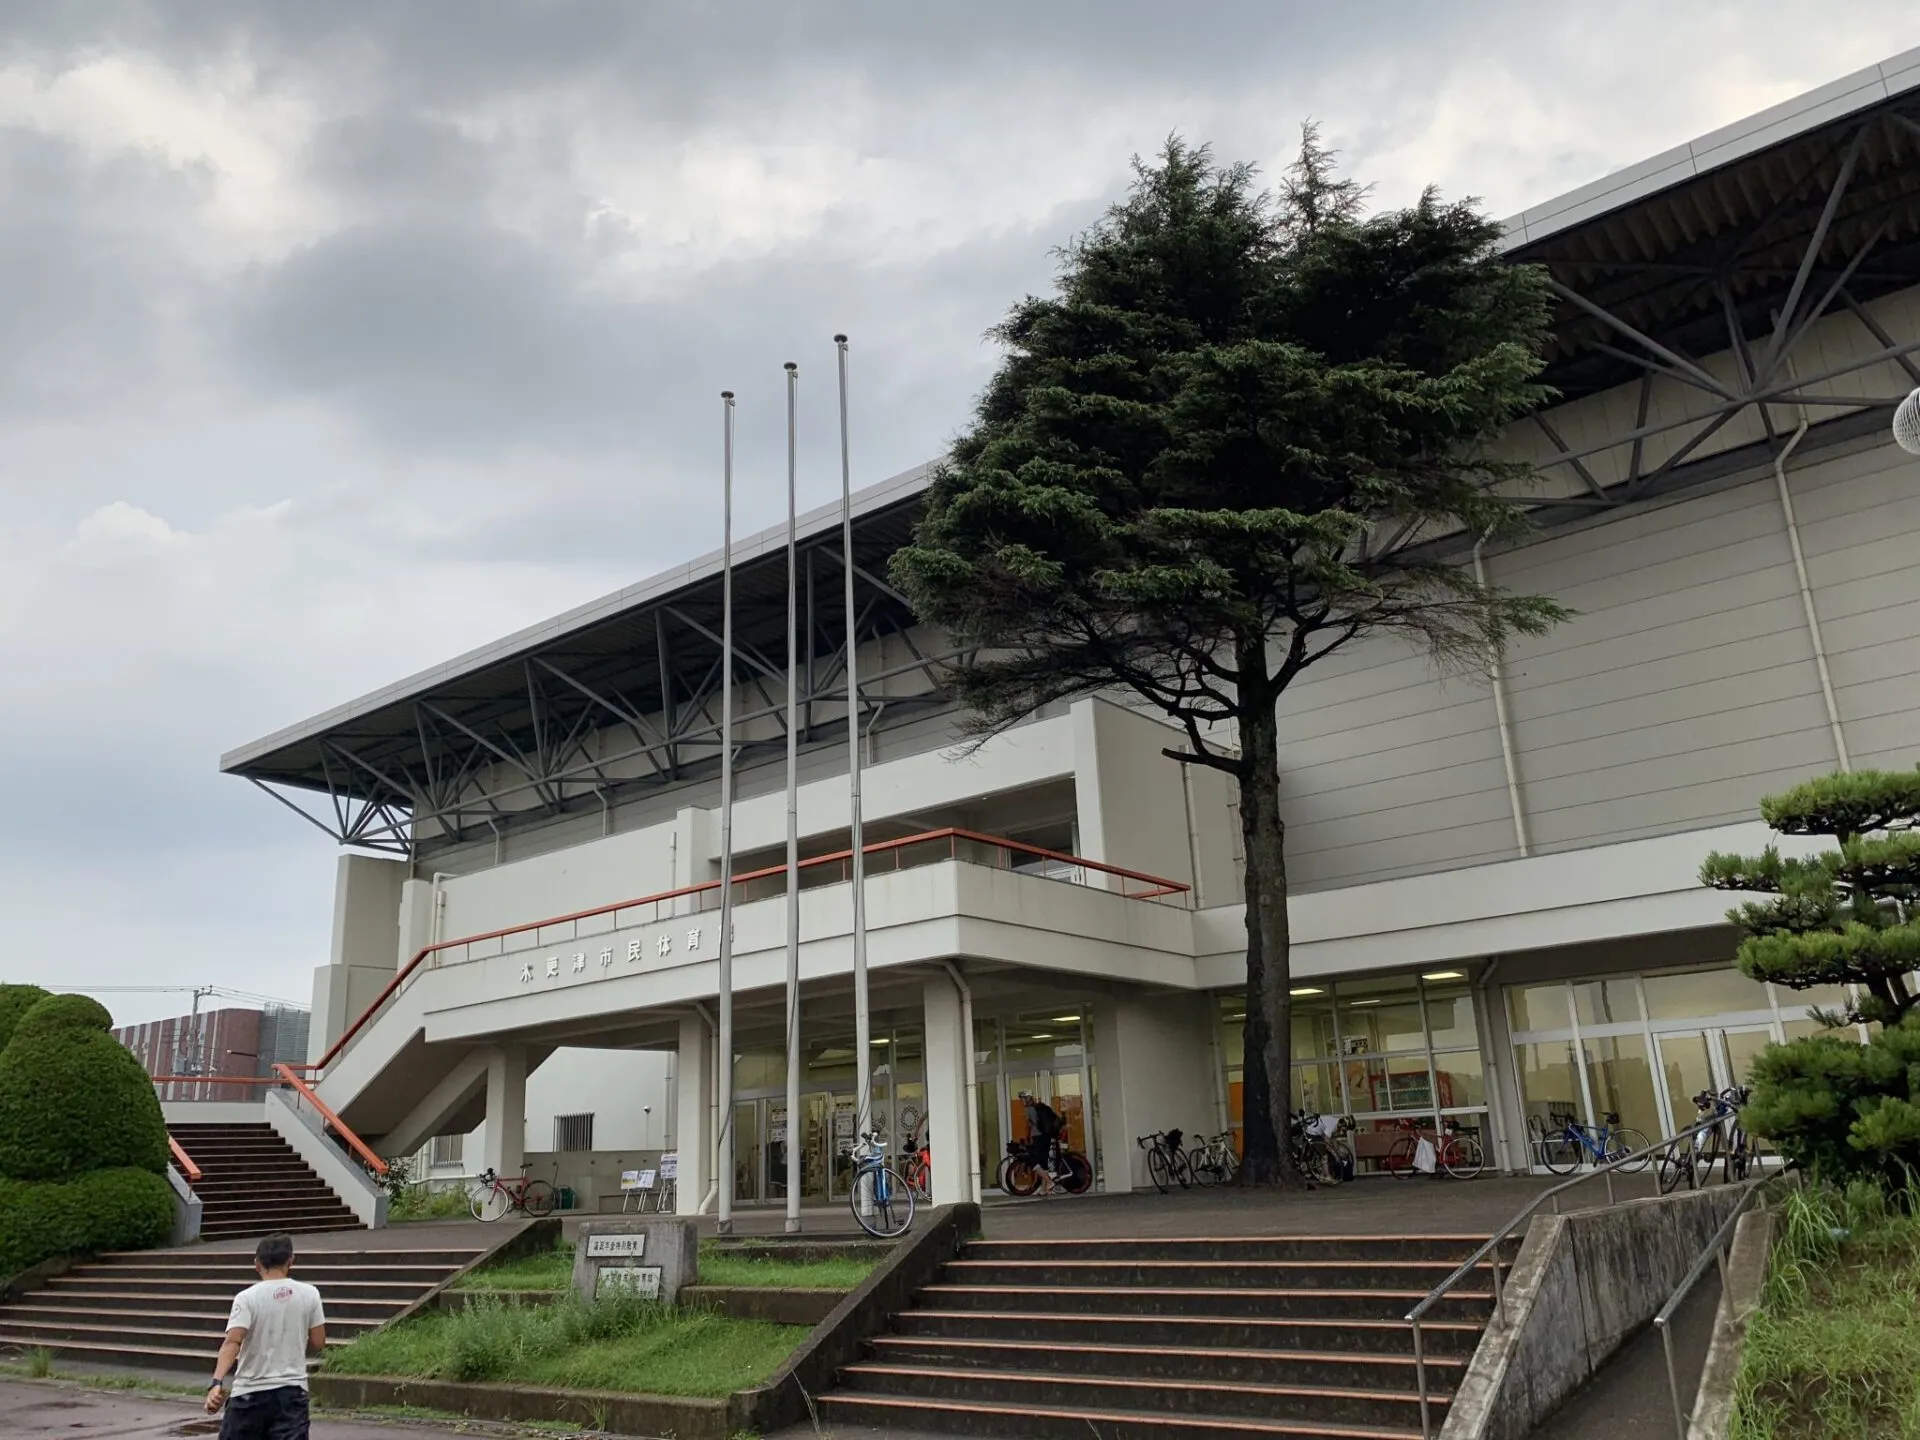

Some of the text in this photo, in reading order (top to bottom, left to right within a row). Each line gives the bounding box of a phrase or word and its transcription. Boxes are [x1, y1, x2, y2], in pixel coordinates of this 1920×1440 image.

[520, 922, 734, 984] 木更津市民体育
